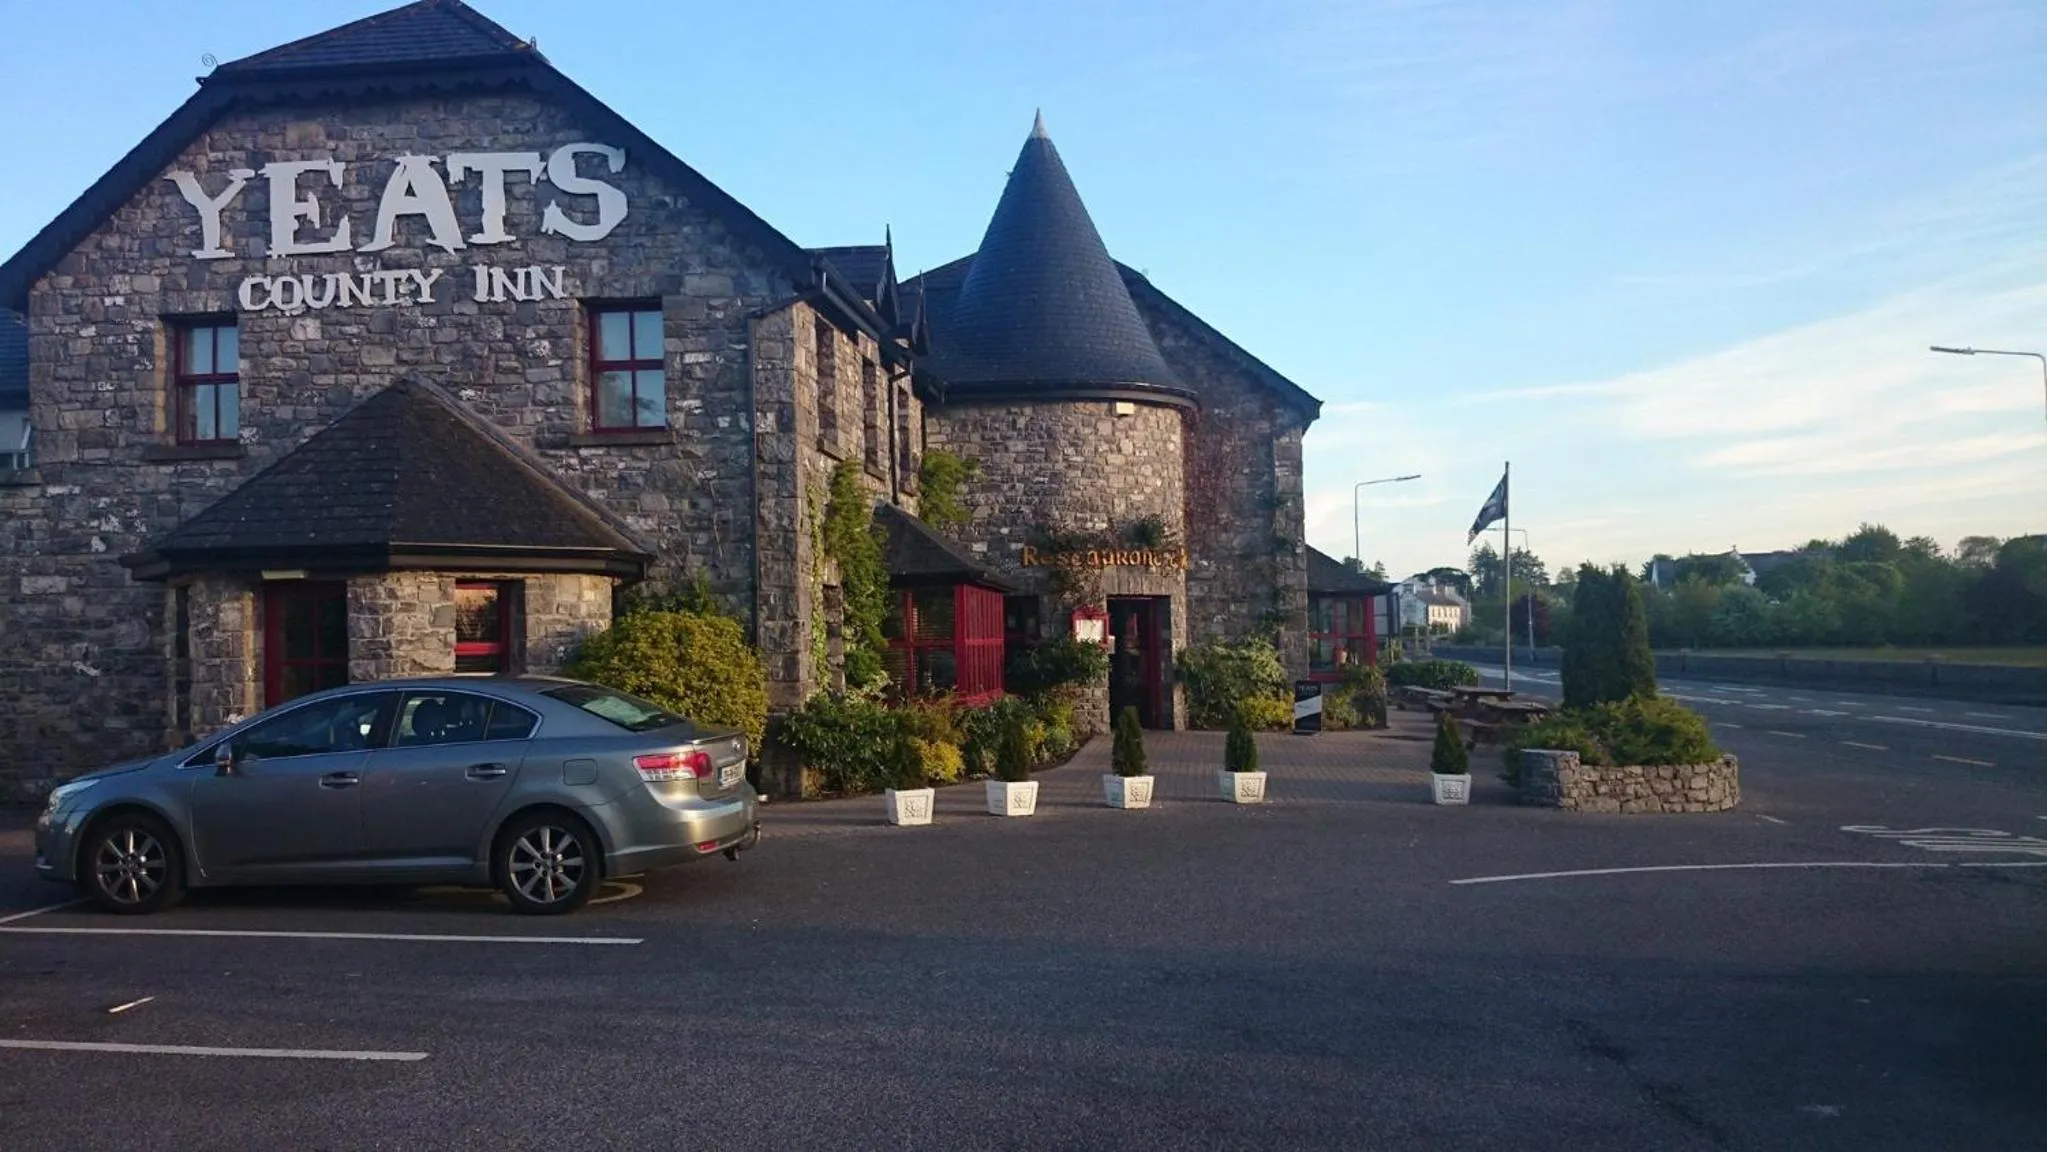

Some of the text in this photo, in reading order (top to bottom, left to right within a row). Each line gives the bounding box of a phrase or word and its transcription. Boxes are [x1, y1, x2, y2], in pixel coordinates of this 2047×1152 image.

[163, 142, 628, 260] YEATS
[238, 264, 568, 311] COUNTY INN
